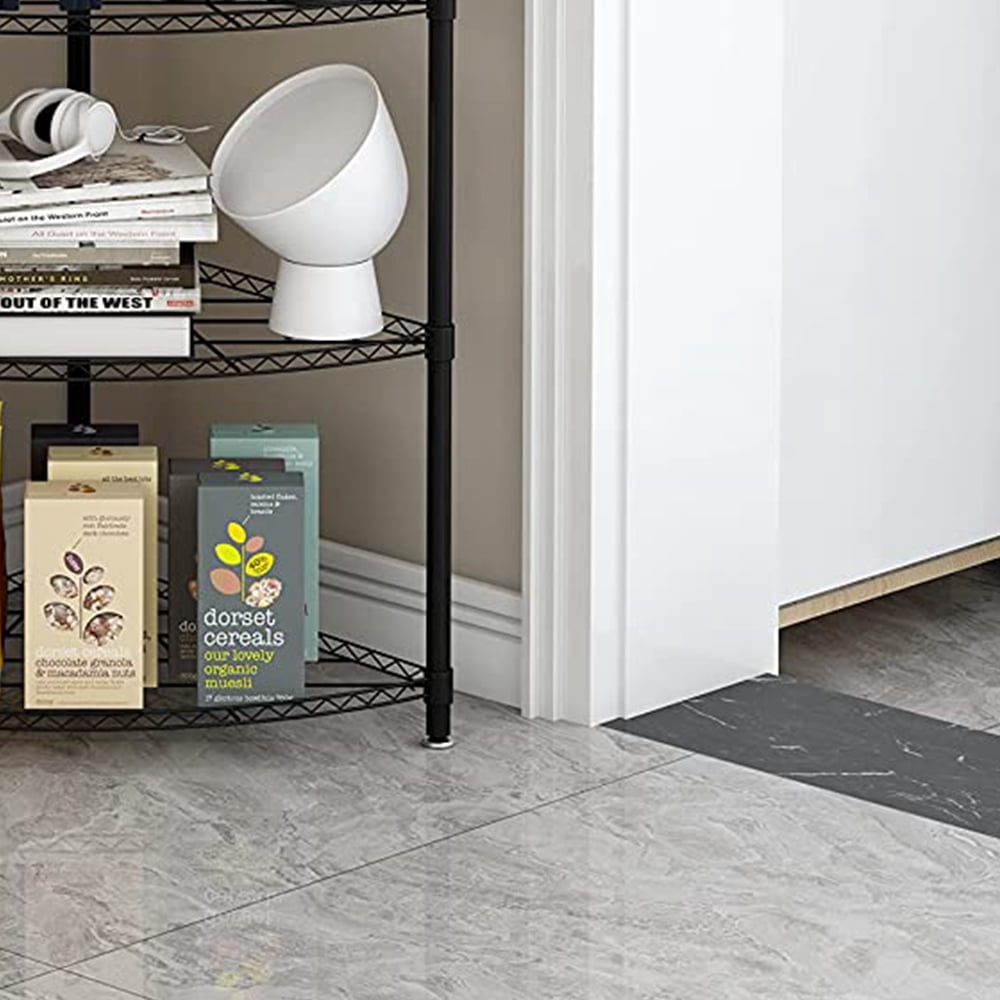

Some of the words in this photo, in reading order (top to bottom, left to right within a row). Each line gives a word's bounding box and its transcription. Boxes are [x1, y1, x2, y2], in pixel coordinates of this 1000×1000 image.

[0, 297, 37, 309] OUT
[40, 297, 67, 309] OF
[69, 297, 98, 309] THE
[101, 297, 153, 309] WEST
[203, 608, 276, 626] dorset
[203, 628, 285, 646] cereals
[203, 651, 231, 661] our
[233, 650, 275, 663] lovely
[35, 658, 87, 668] chocolate
[90, 658, 133, 669] granola
[35, 669, 45, 678] &
[47, 669, 109, 678] macadamia
[111, 669, 136, 678] nuts
[203, 664, 258, 676] organic
[204, 677, 253, 689] muesli
